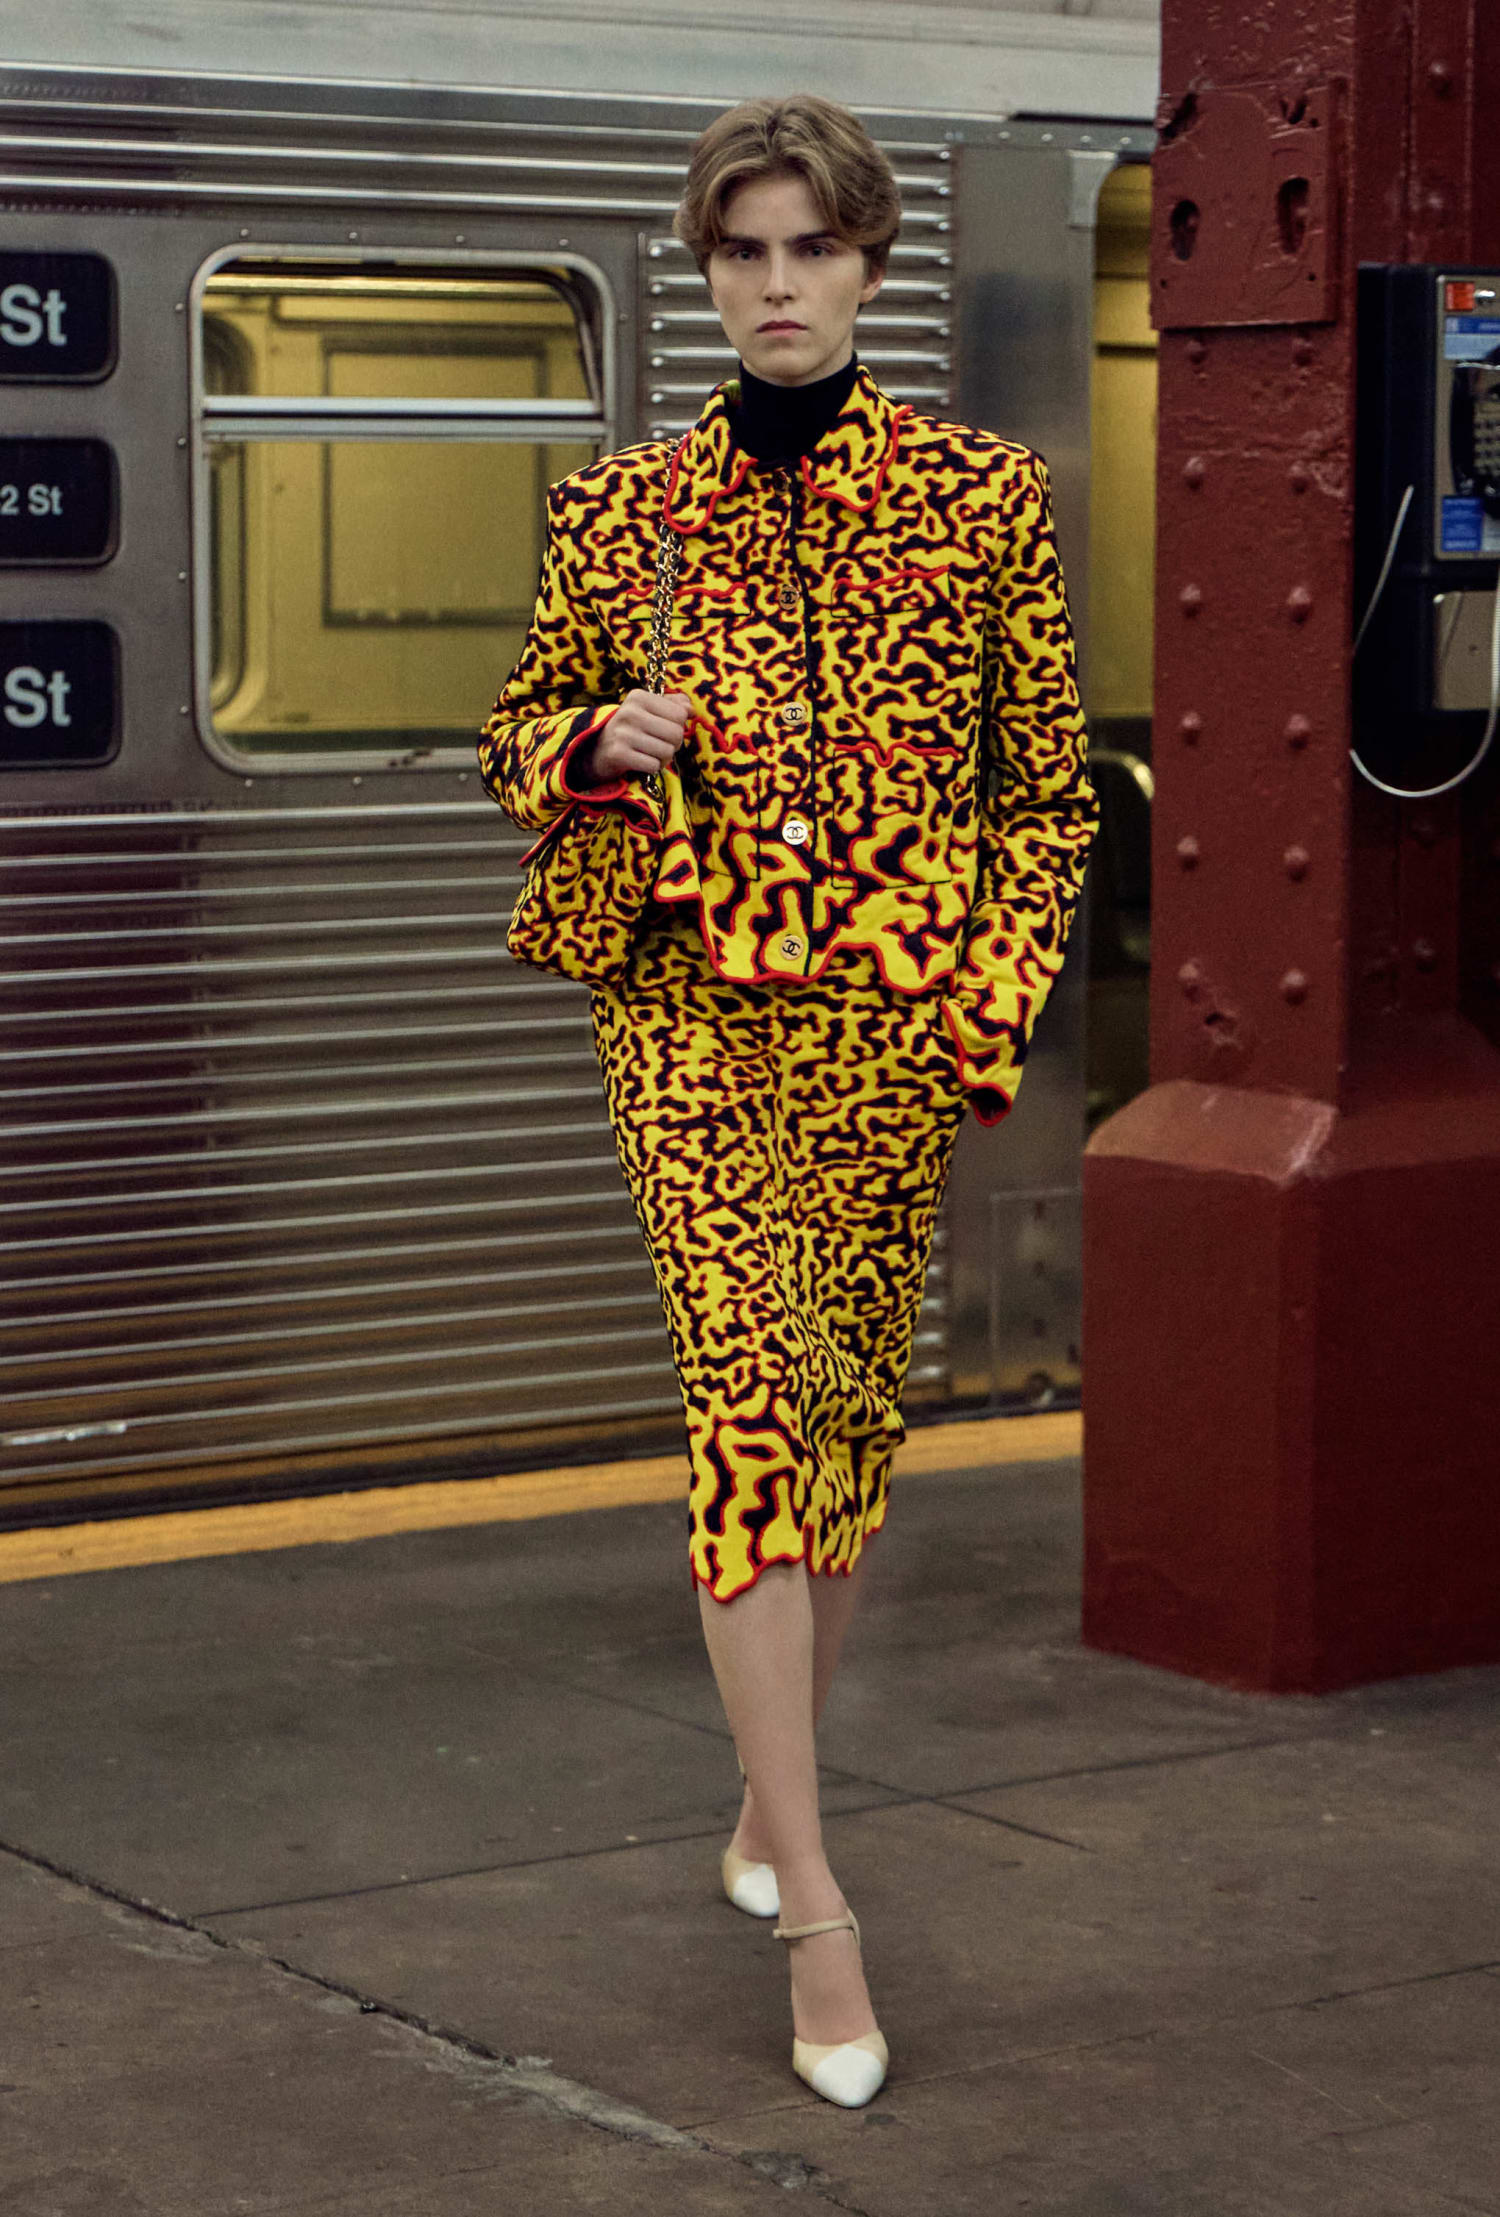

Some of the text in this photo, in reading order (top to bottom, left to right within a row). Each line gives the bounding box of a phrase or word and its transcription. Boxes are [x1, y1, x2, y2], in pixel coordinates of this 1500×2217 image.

[0, 284, 68, 346] St
[28, 484, 63, 516] St
[4, 666, 71, 727] St
